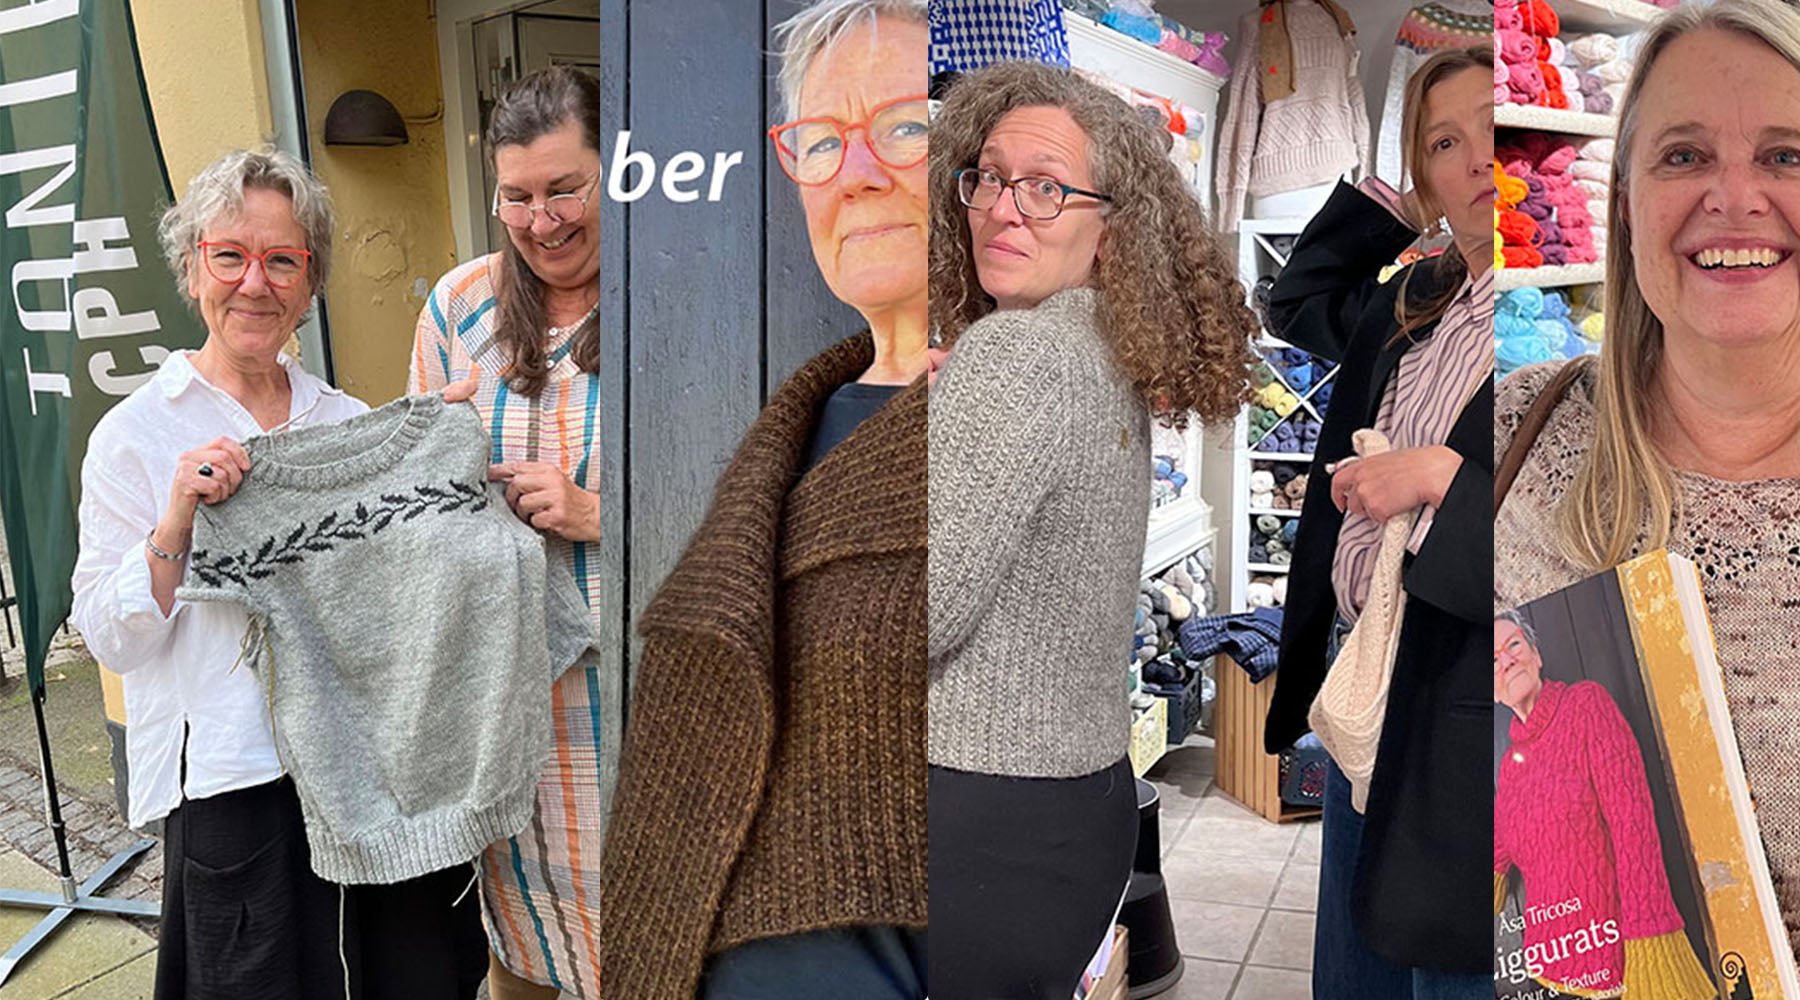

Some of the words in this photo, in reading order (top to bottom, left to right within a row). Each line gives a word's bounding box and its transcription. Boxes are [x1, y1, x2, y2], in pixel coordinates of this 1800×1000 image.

[73, 217, 171, 396] CPH
[1526, 897, 1582, 926] Tricosa
[1494, 919, 1620, 984] iggurats
[1560, 968, 1611, 993] Texture
